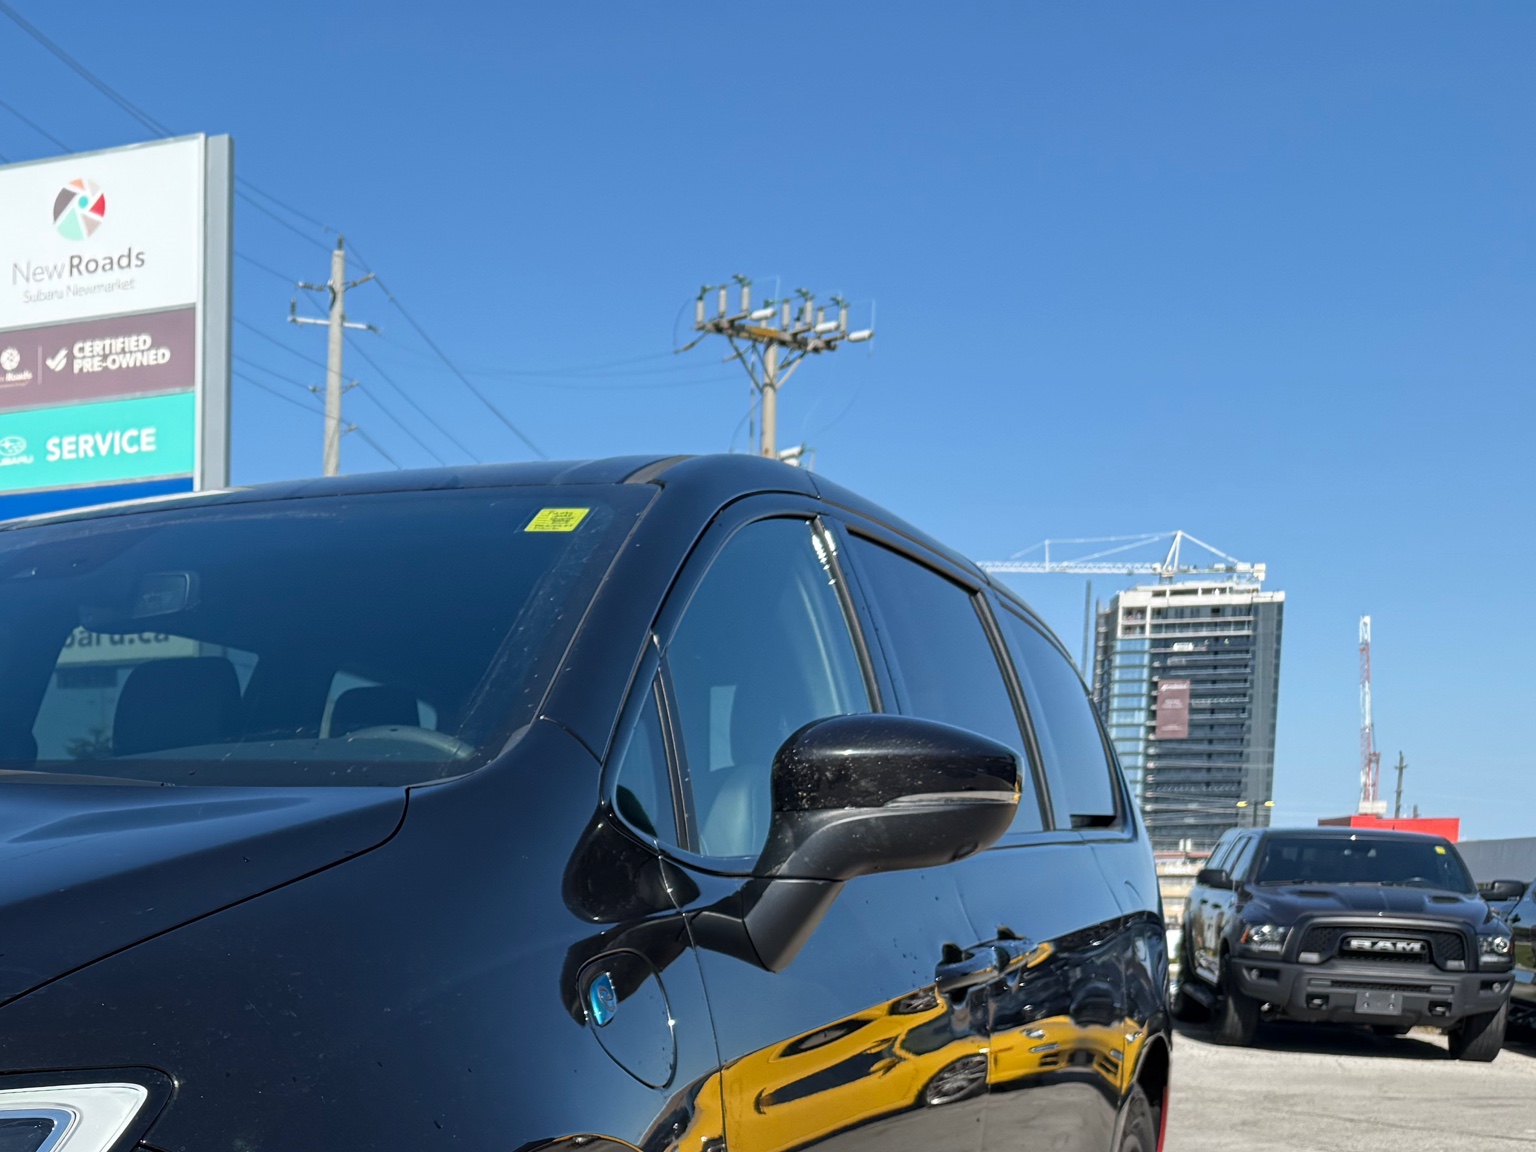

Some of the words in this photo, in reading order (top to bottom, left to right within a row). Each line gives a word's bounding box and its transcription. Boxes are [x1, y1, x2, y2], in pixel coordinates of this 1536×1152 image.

[23, 288, 64, 304] Subaru
[66, 277, 136, 298] Newmarket
[72, 333, 152, 358] CERTIFIED
[72, 346, 171, 375] PRE-OWNED
[45, 426, 157, 463] SERVICE
[1350, 939, 1422, 952] RAM
